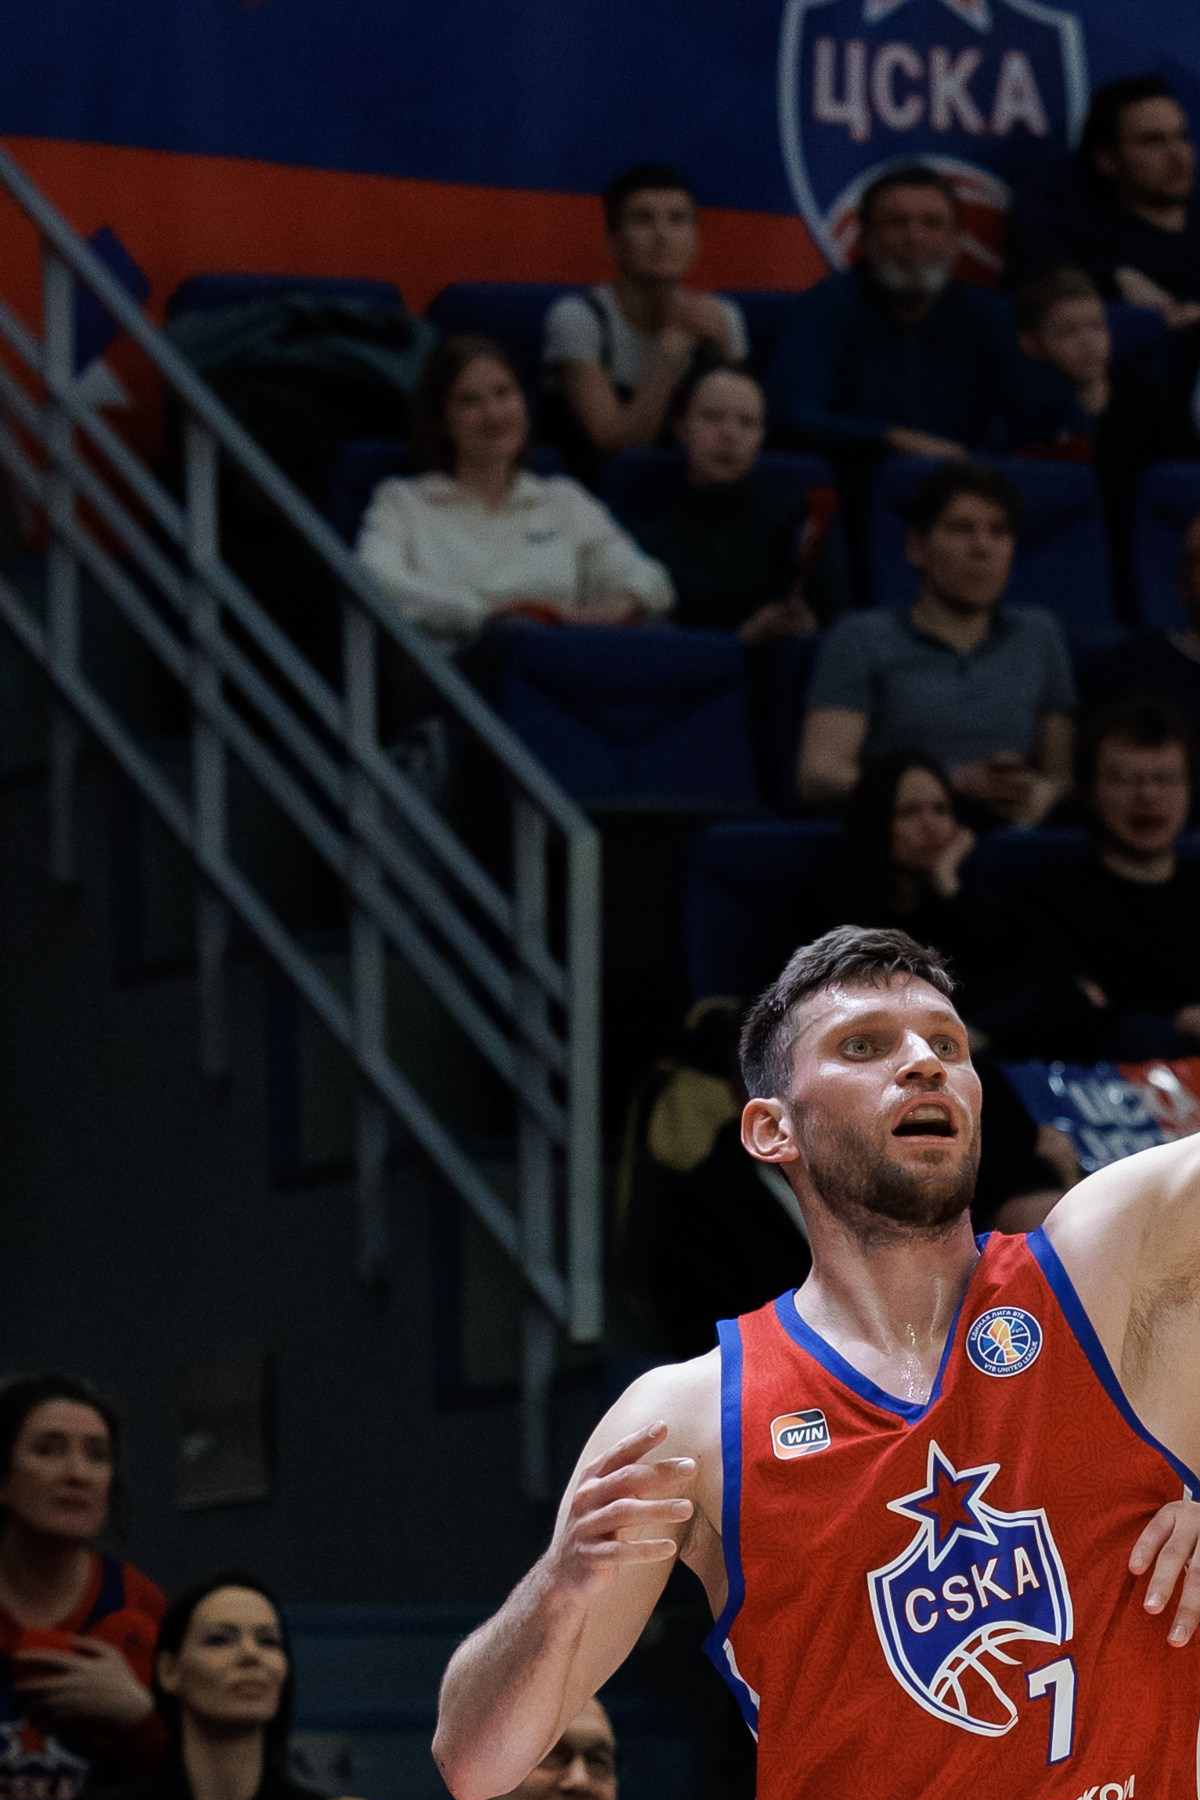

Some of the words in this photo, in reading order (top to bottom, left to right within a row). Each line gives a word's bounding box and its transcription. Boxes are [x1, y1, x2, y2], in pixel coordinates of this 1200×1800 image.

[812, 35, 1053, 144] ЦСКА
[997, 1363, 1022, 1373] UNITED
[1022, 1341, 1038, 1364] LEAGUE
[787, 1425, 824, 1445] WIN
[905, 1546, 1041, 1633] CSKA
[1025, 1654, 1077, 1766] 7
